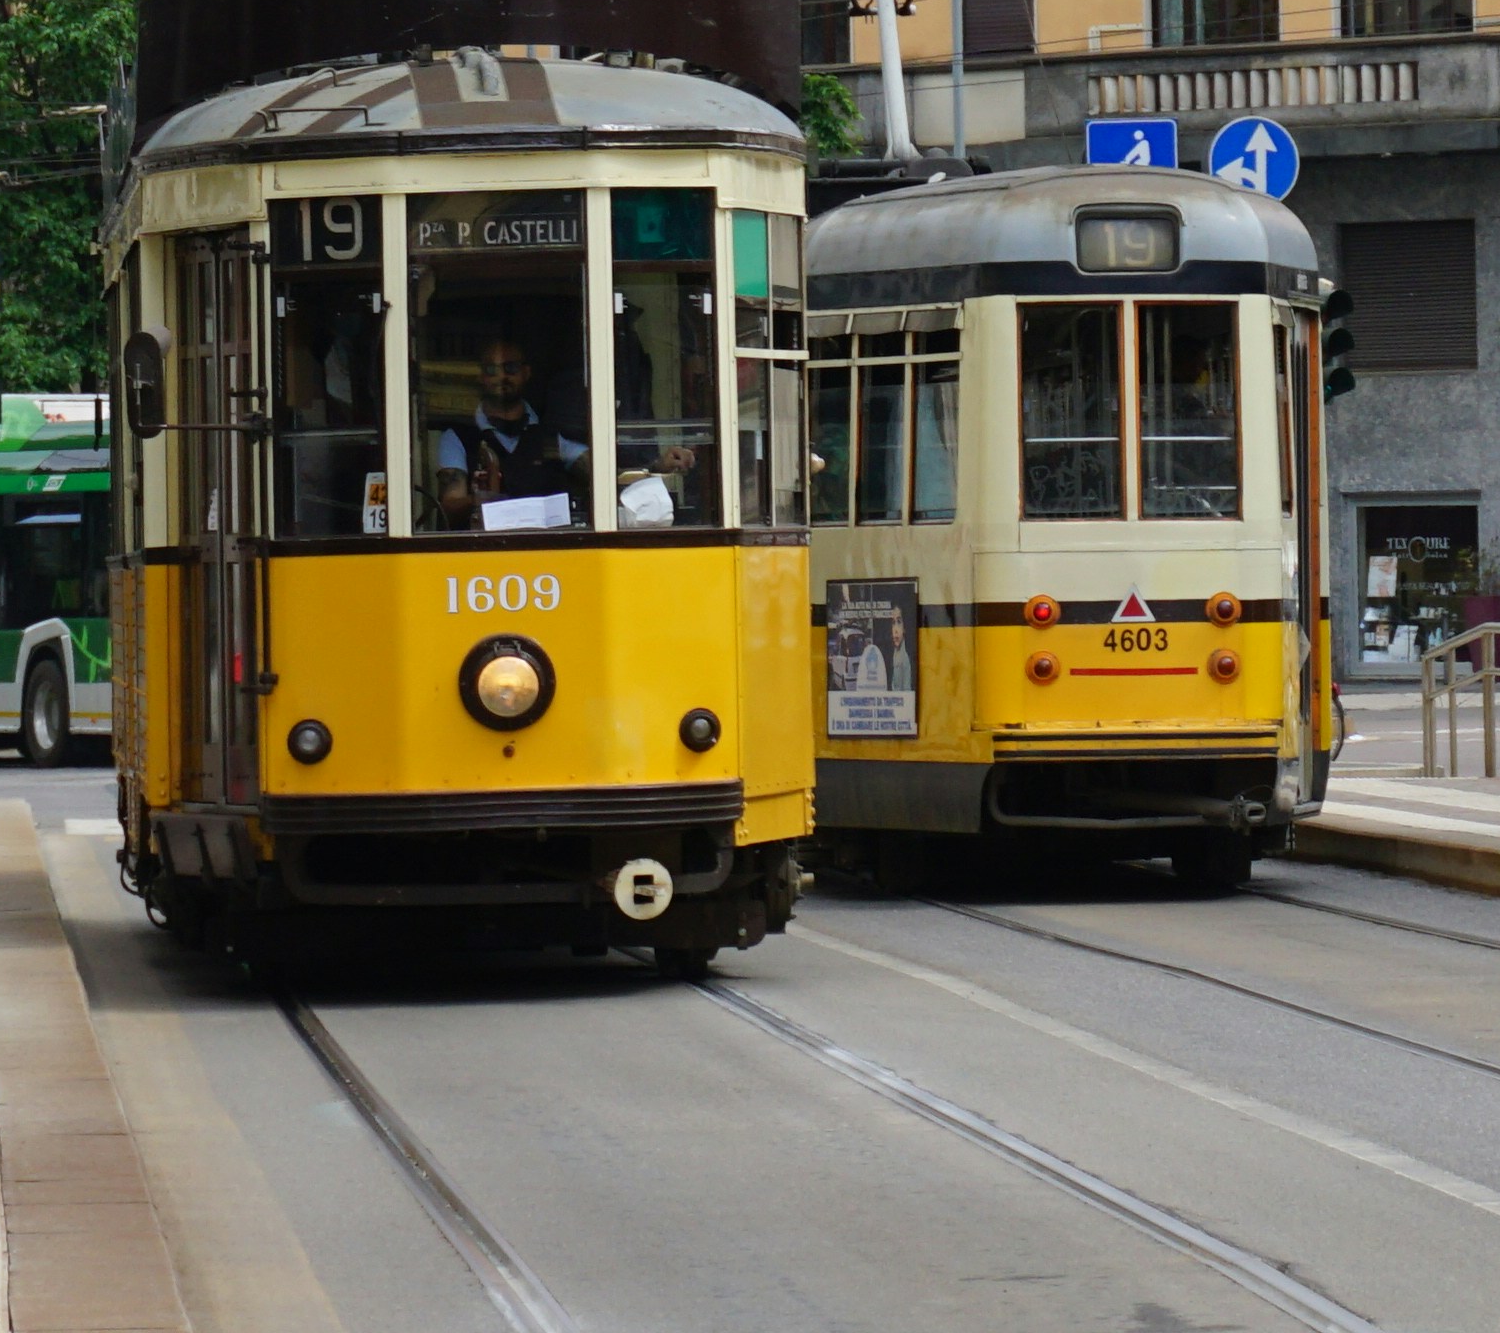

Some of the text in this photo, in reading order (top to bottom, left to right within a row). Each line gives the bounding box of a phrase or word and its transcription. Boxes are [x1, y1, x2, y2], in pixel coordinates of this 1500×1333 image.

[299, 195, 363, 262] 19
[483, 219, 578, 245] CASTELLI
[1103, 222, 1155, 268] 19
[369, 508, 388, 528] 19
[446, 573, 561, 614] 1609
[1102, 627, 1169, 652] 4603
